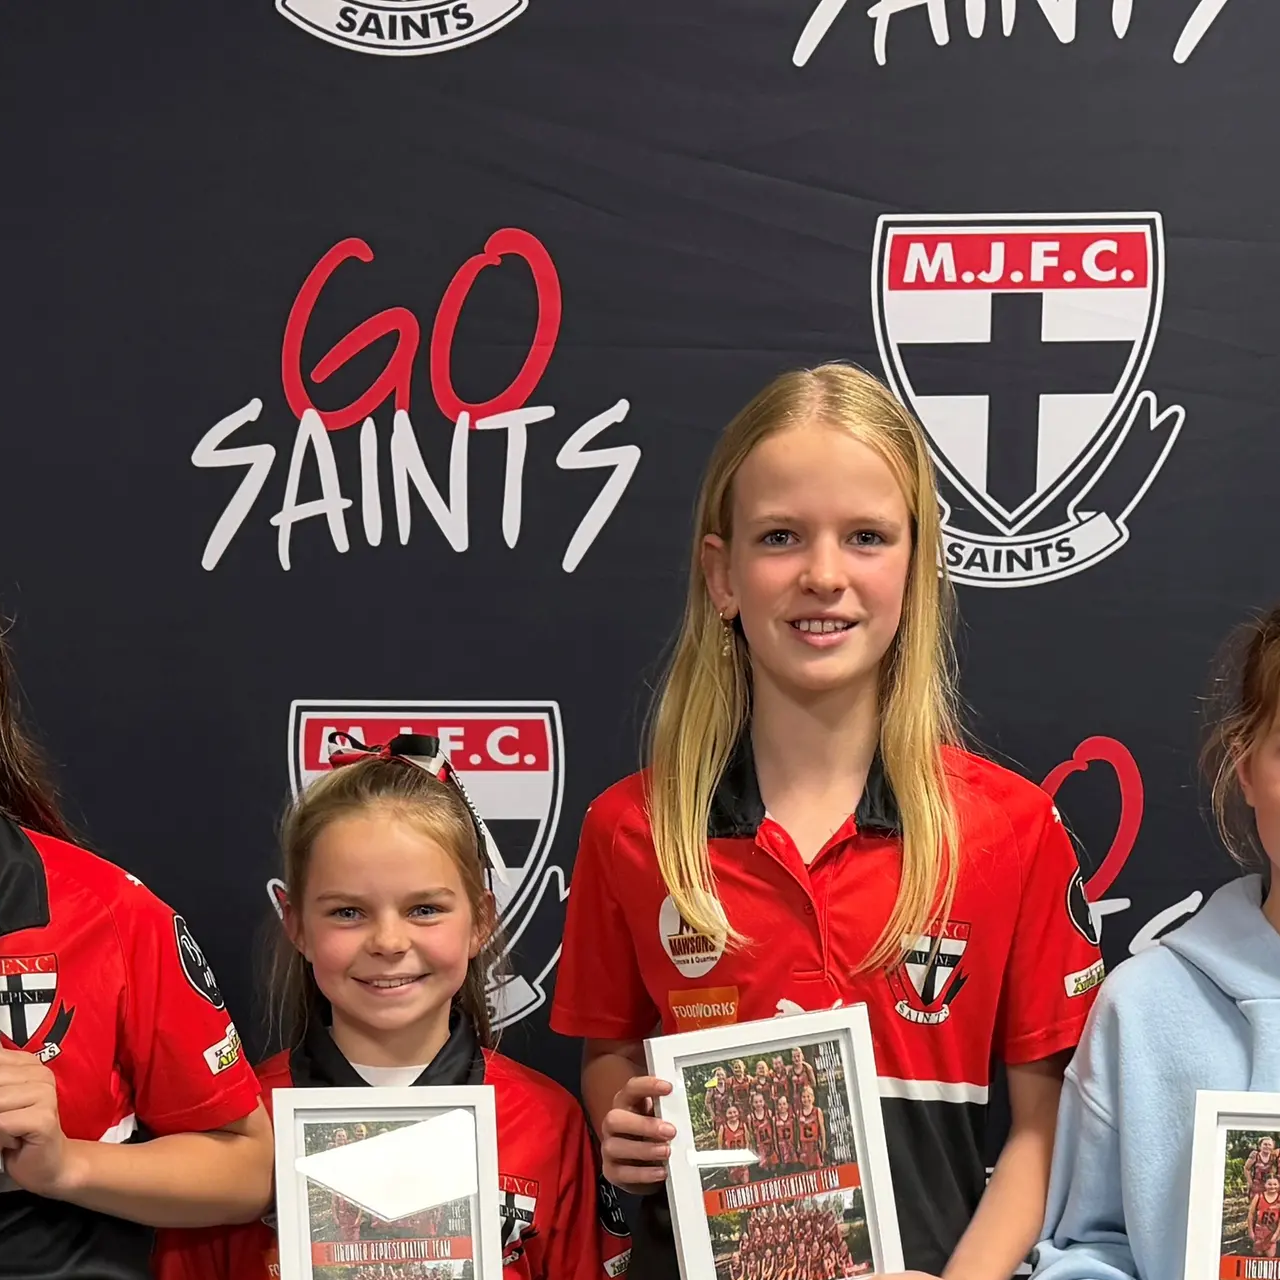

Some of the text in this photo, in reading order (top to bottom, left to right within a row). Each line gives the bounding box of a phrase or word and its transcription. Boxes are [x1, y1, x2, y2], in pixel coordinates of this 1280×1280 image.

[335, 1, 475, 42] SAINTS
[903, 240, 1135, 284] M.J.F.C.
[282, 227, 562, 430] GO
[190, 397, 641, 573] SAINTS
[945, 537, 1077, 575] SAINTS
